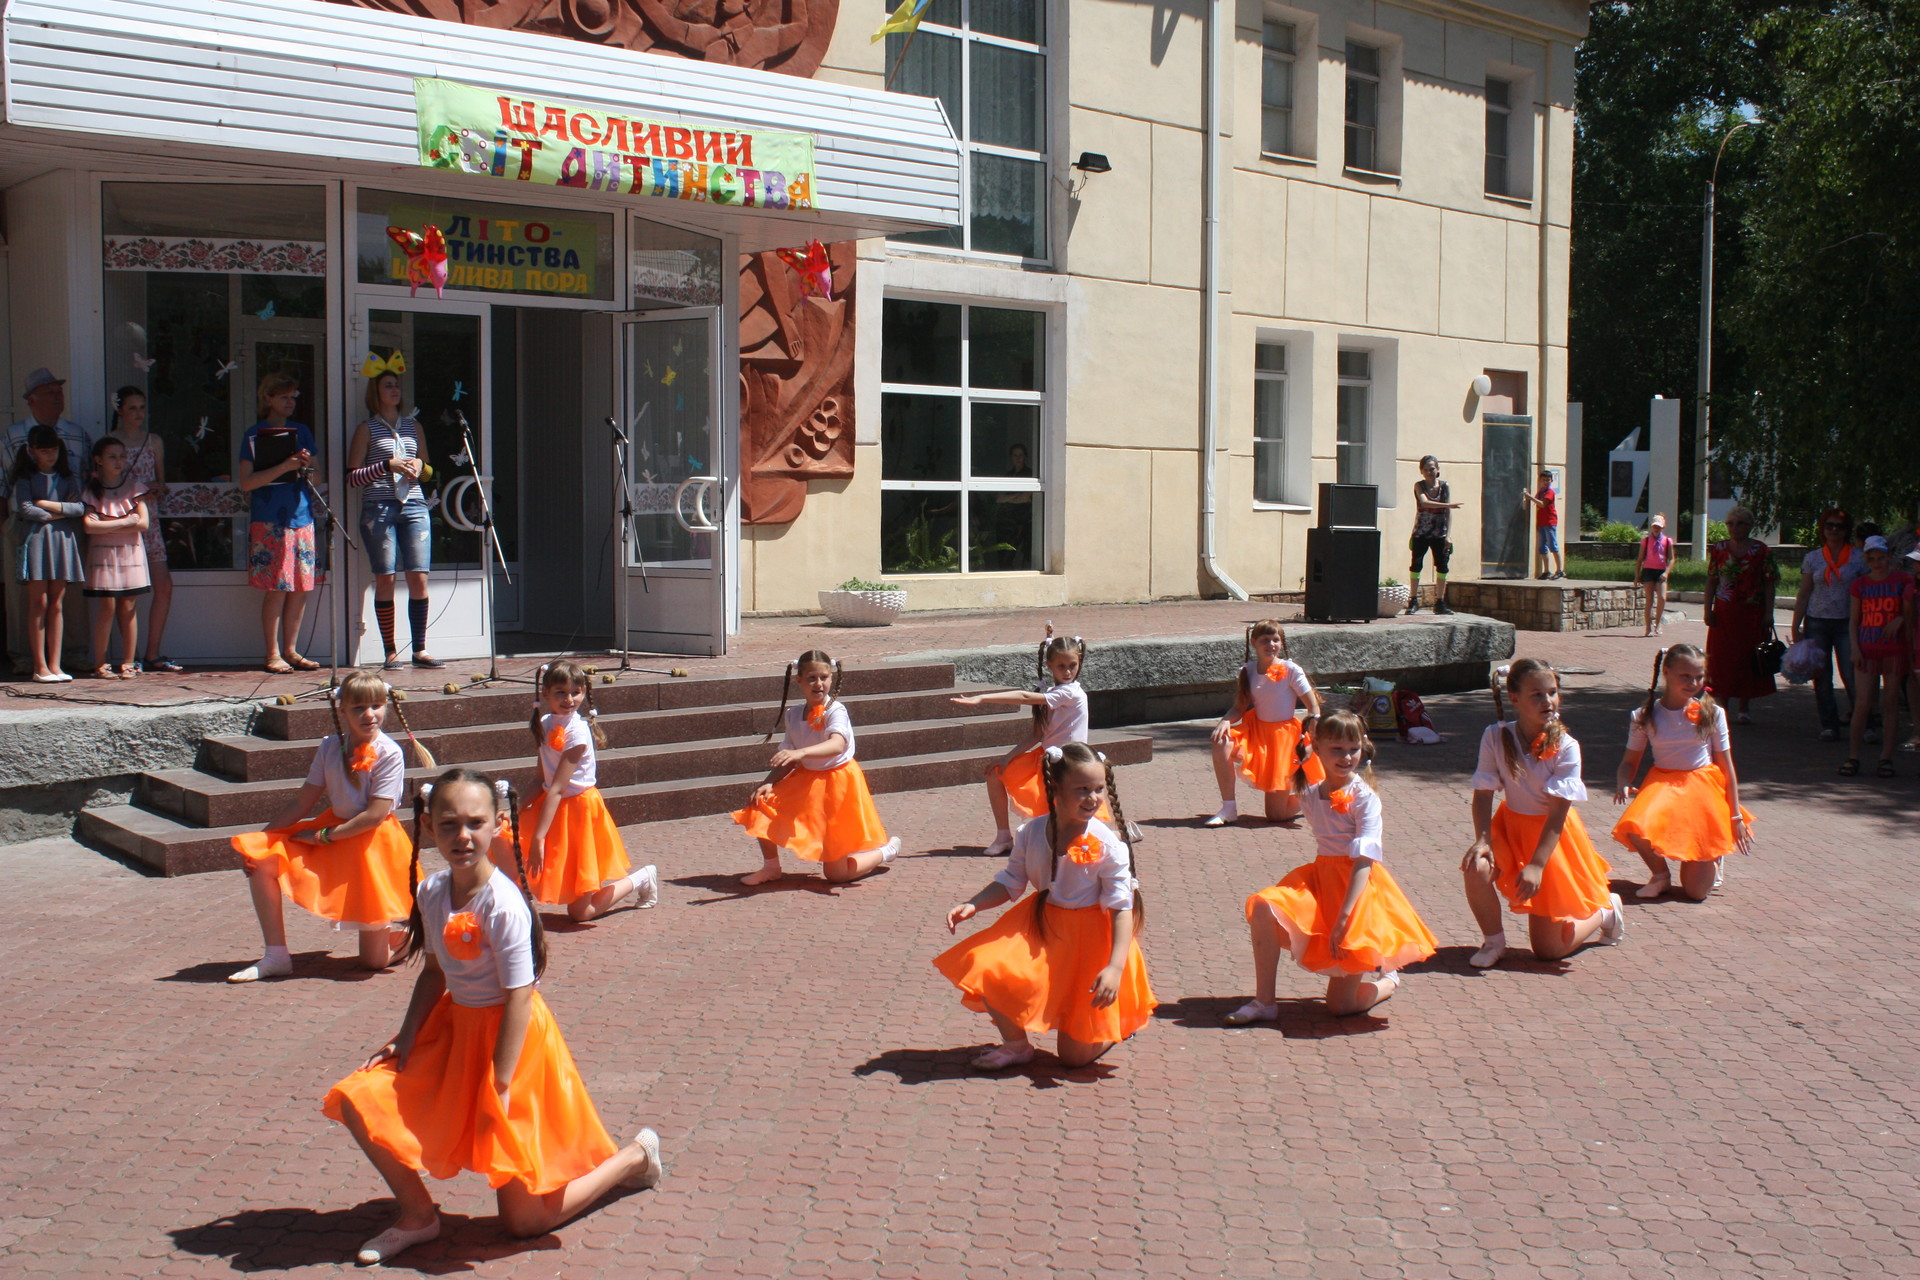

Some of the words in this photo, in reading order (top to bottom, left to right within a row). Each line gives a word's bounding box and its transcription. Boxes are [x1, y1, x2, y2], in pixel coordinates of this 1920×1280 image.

[496, 96, 754, 167] ЩАСЛИВИЙ
[429, 124, 543, 181] СВІТ
[555, 146, 813, 211] ДИТИНСТВА
[403, 239, 580, 270] ТИНСТВА
[391, 257, 514, 290] ЩЛИВА
[525, 269, 588, 293] ПОРА
[1859, 582, 1904, 598] SMILE
